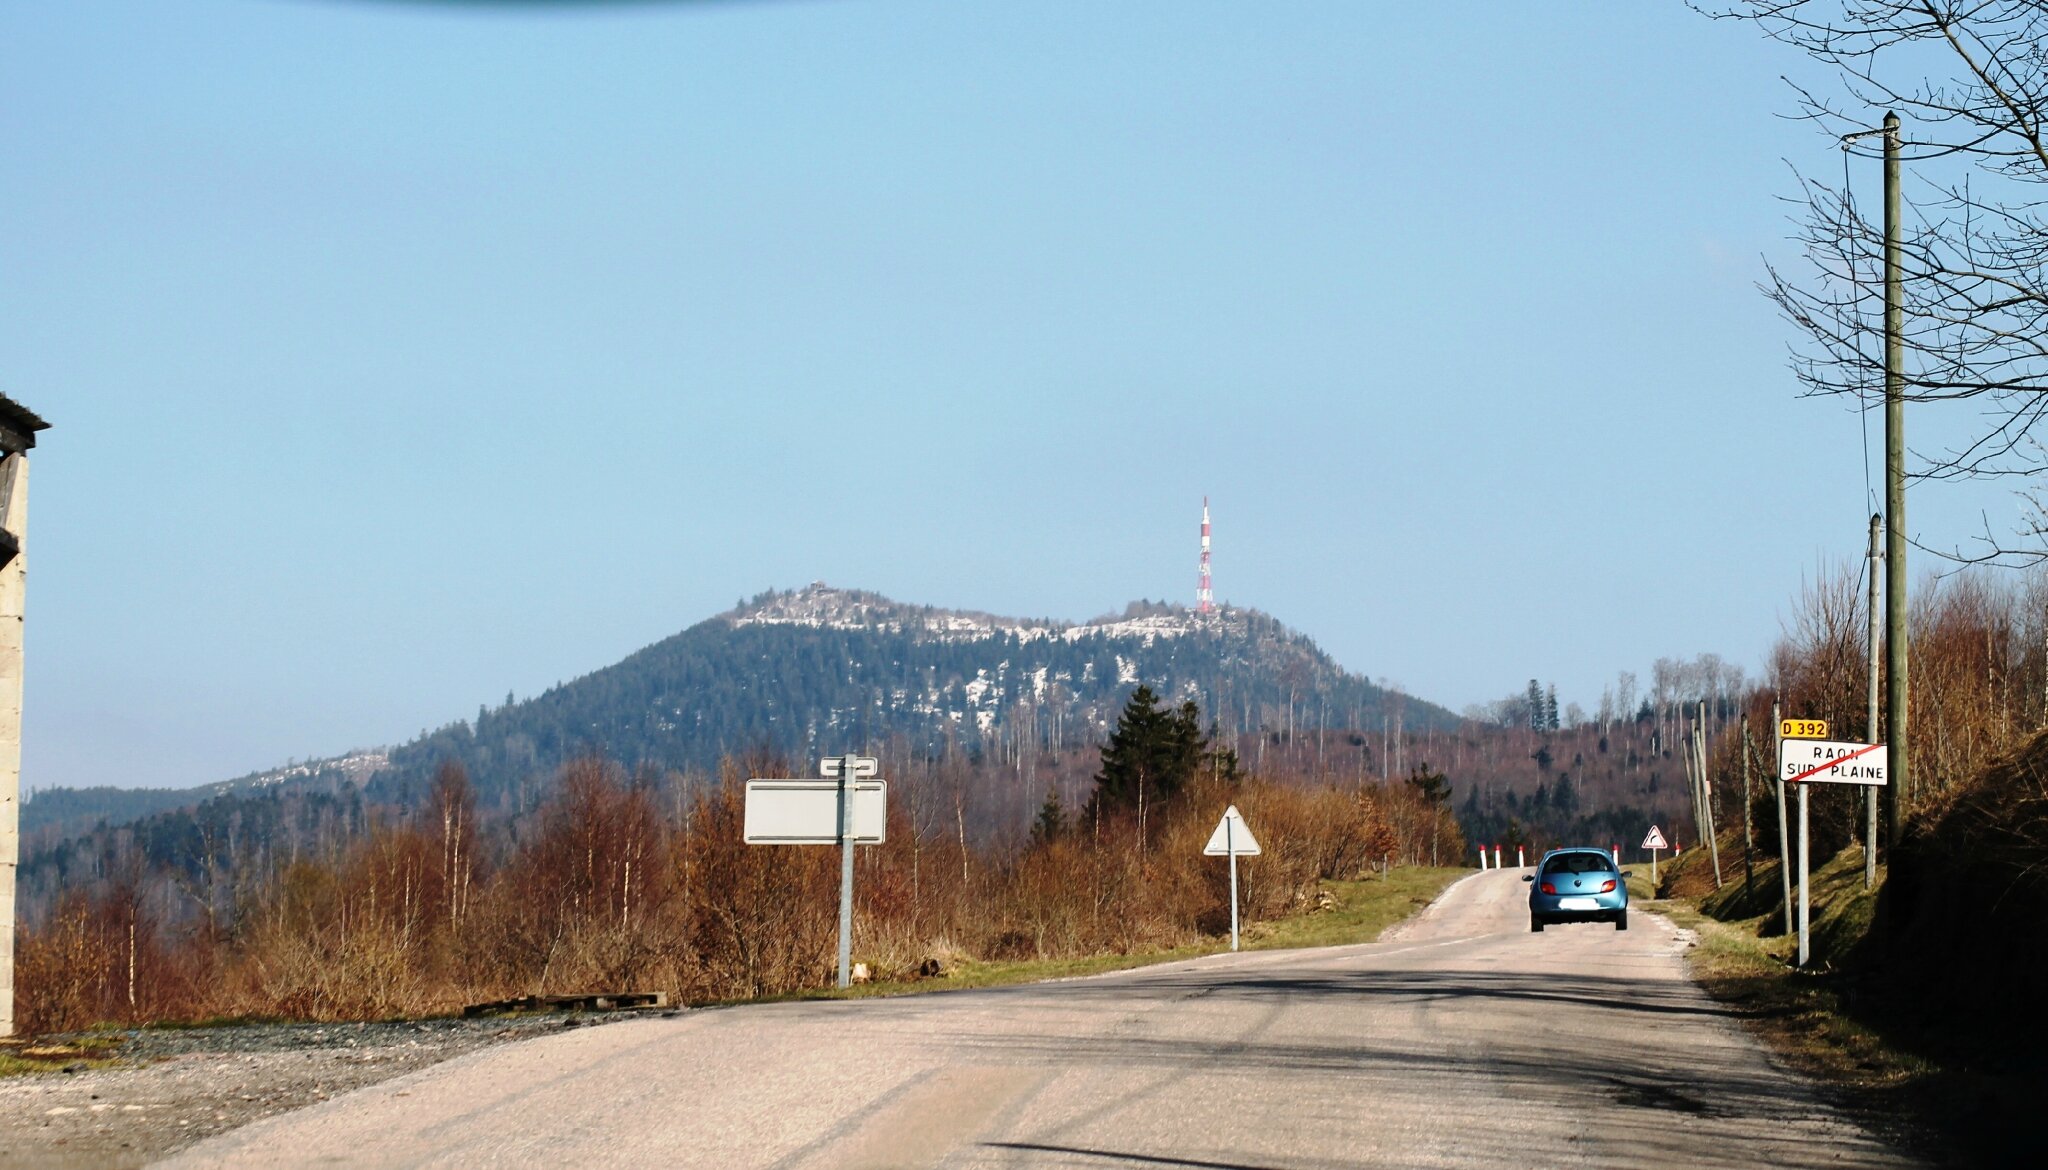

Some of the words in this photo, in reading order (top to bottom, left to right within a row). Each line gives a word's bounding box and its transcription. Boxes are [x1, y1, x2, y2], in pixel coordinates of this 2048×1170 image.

[1783, 723, 1791, 735] D
[1797, 723, 1825, 735] 392
[1813, 747, 1859, 760] RAON
[1787, 763, 1815, 776] SUR
[1831, 765, 1884, 779] PLAINE
